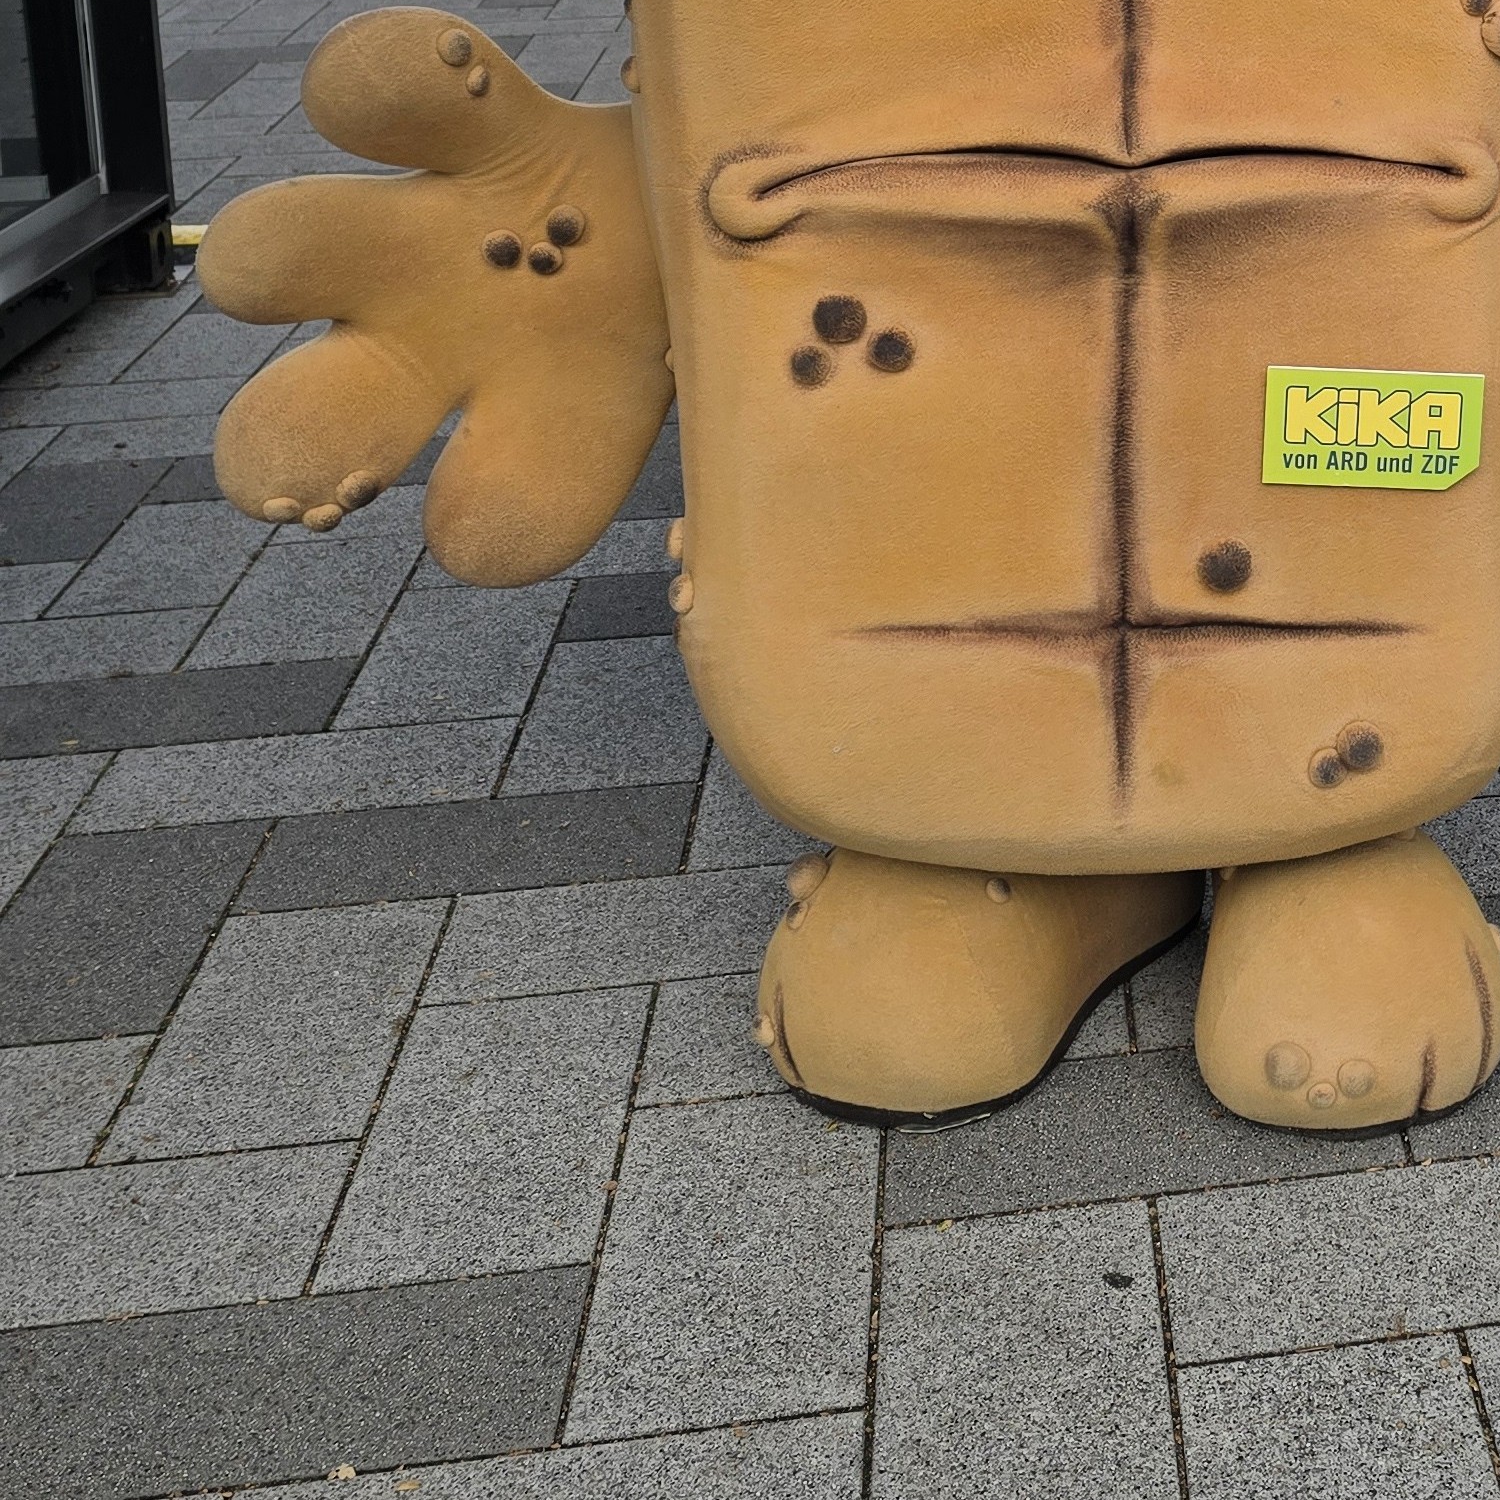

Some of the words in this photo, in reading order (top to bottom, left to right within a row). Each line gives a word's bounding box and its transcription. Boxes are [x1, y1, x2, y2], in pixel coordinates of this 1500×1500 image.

[1283, 453, 1317, 470] von
[1326, 451, 1368, 471] ARD
[1377, 454, 1413, 473] und
[1421, 454, 1460, 475] ZDF
